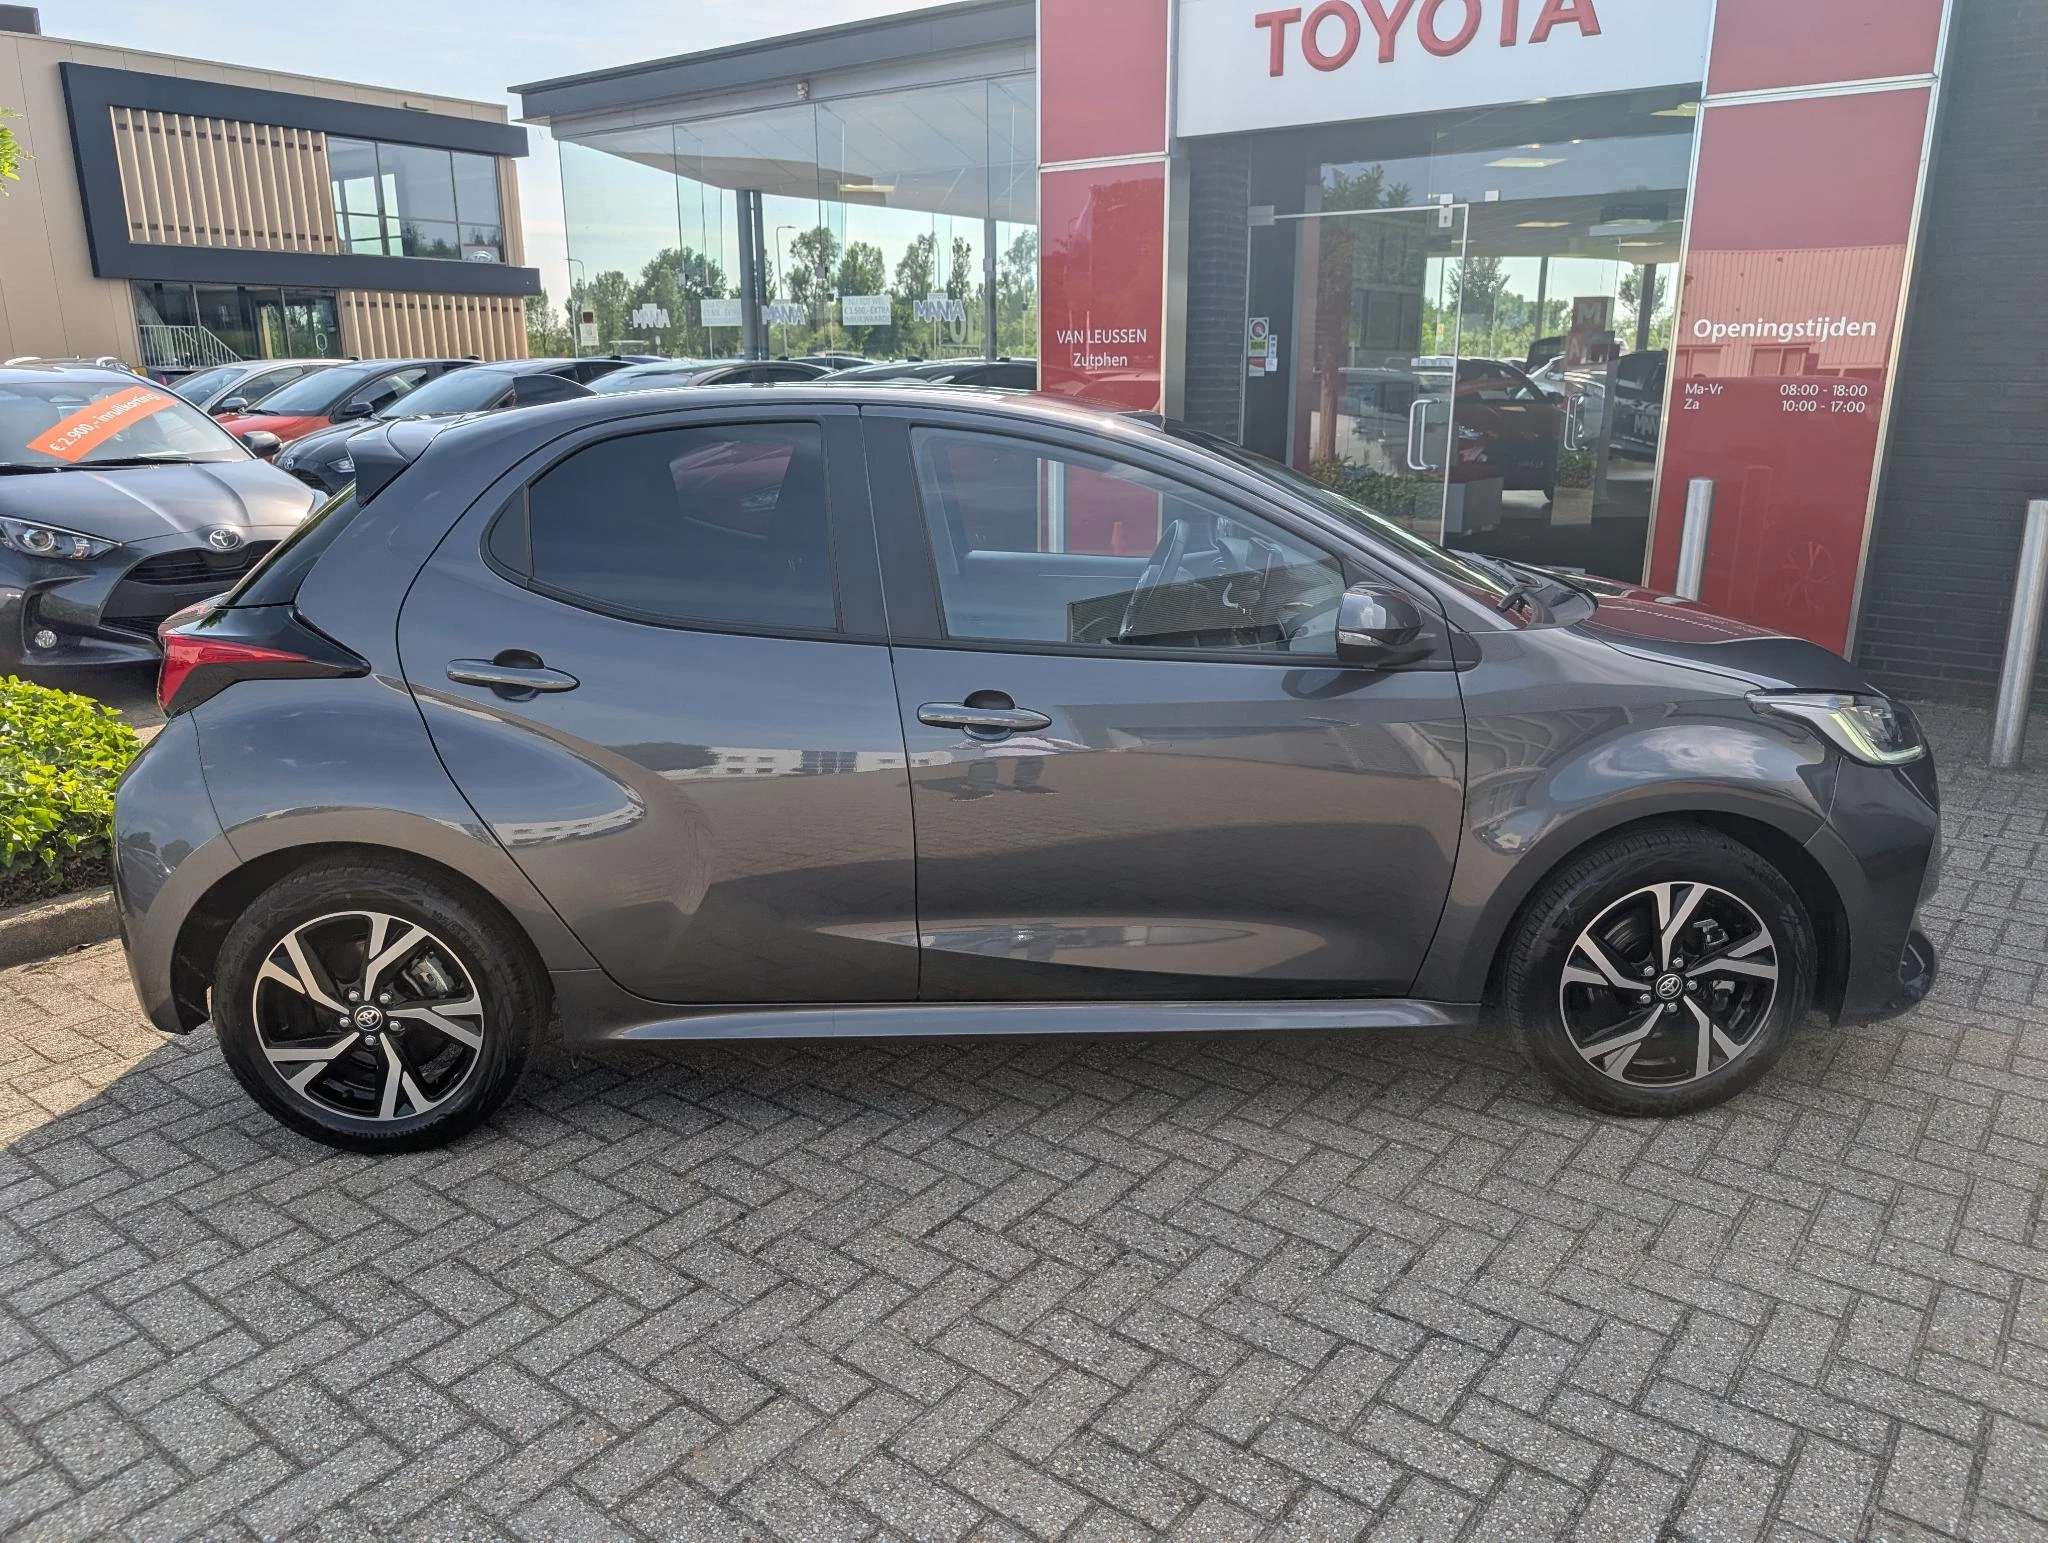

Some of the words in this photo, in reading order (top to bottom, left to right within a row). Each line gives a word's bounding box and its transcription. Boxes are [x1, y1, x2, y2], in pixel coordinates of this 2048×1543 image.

[1255, 0, 1602, 77] TOYOTA
[913, 299, 966, 323] MANIA
[1056, 329, 1084, 344] VAN
[1087, 328, 1148, 344] LEUSSEN
[1693, 316, 1877, 343] Openingstijden
[1073, 352, 1128, 371] Zutphen
[1685, 383, 1724, 395] Ma-Vr
[1779, 384, 1819, 397] 08:00
[1832, 384, 1868, 397] 18:00
[1682, 398, 1700, 410] Za
[1781, 400, 1817, 412] 10:00
[1830, 401, 1866, 413] 17:00
[49, 442, 66, 451] €
